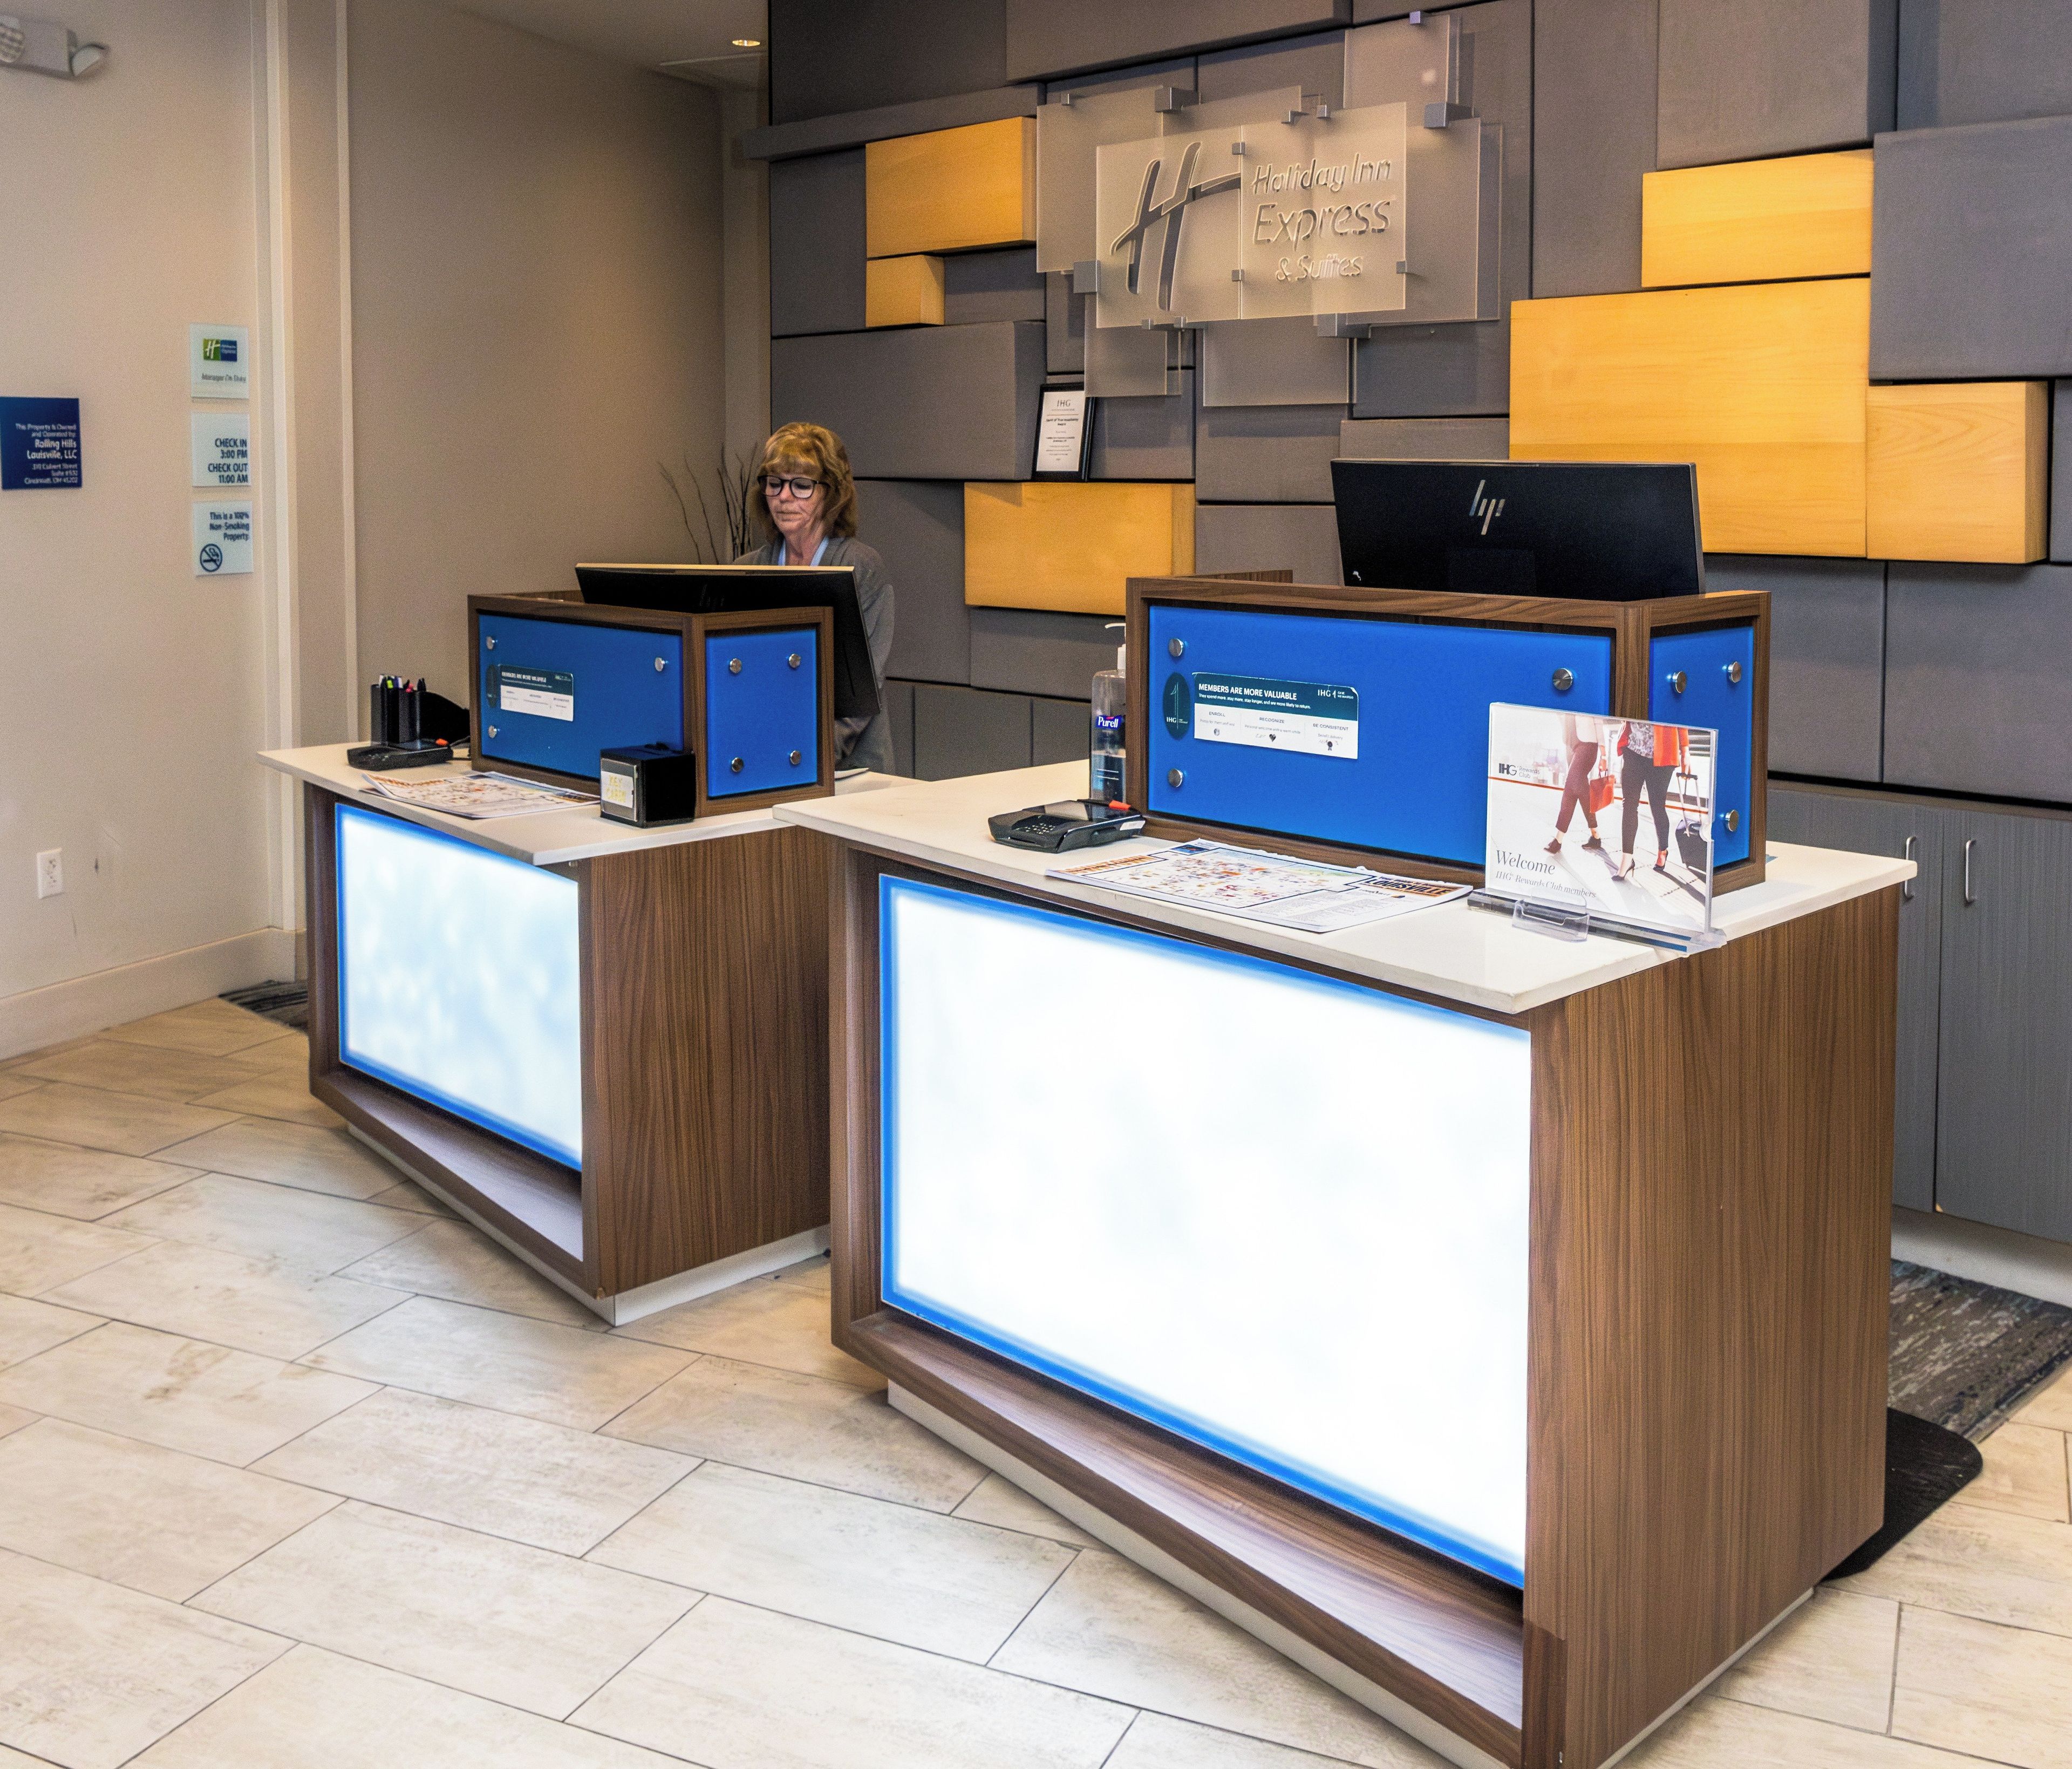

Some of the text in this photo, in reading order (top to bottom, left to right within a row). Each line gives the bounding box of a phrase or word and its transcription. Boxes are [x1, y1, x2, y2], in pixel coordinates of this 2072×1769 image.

[1252, 153, 1391, 193] Holiday Inn
[1253, 199, 1391, 251] Express
[1276, 254, 1364, 281] & Suites
[35, 439, 76, 450] Rolling Hills
[215, 438, 247, 448] CHECK IN
[27, 450, 77, 460] Louisville, LLC
[221, 450, 247, 459] 3:00 PM
[208, 463, 248, 472] CHECK OUT
[219, 474, 248, 484] 11:00 AM
[223, 512, 228, 520] is
[223, 533, 249, 541] Property
[1199, 683, 1229, 693] MEMBERS
[1244, 688, 1263, 697] MORE
[1264, 690, 1297, 700] VALUABLE
[1098, 716, 1119, 727] Purell
[1499, 763, 1517, 775] IHG
[1497, 850, 1555, 875] Welcome
[1366, 879, 1452, 895] LOUISVILLE
[1516, 875, 1545, 887] Rewards
[1546, 881, 1563, 891] Club
[1564, 887, 1596, 898] members
